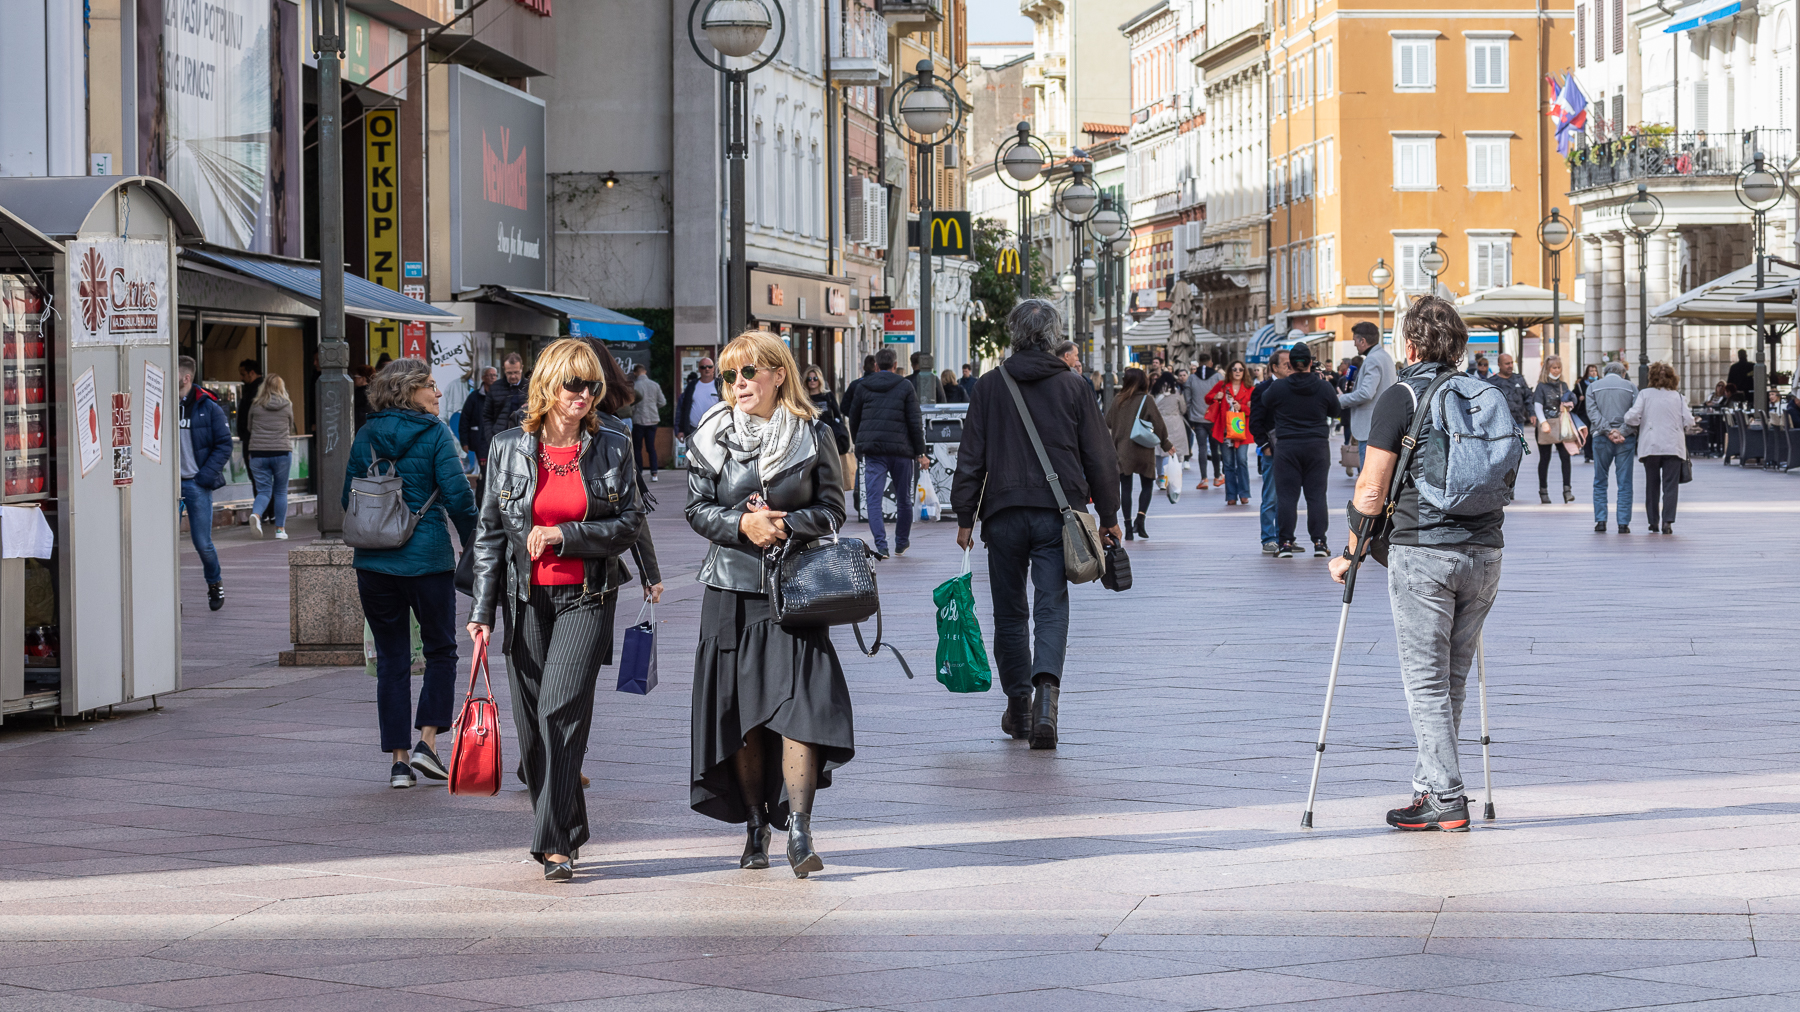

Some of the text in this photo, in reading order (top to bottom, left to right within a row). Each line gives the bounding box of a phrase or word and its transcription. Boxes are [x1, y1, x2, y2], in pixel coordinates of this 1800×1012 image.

[203, 2, 243, 50] POTPUNU
[166, 51, 215, 101] SIGURNOST
[370, 115, 394, 239] OTKUP
[373, 251, 395, 371] ZTA
[892, 319, 913, 327] Lutrija
[115, 408, 124, 425] 50
